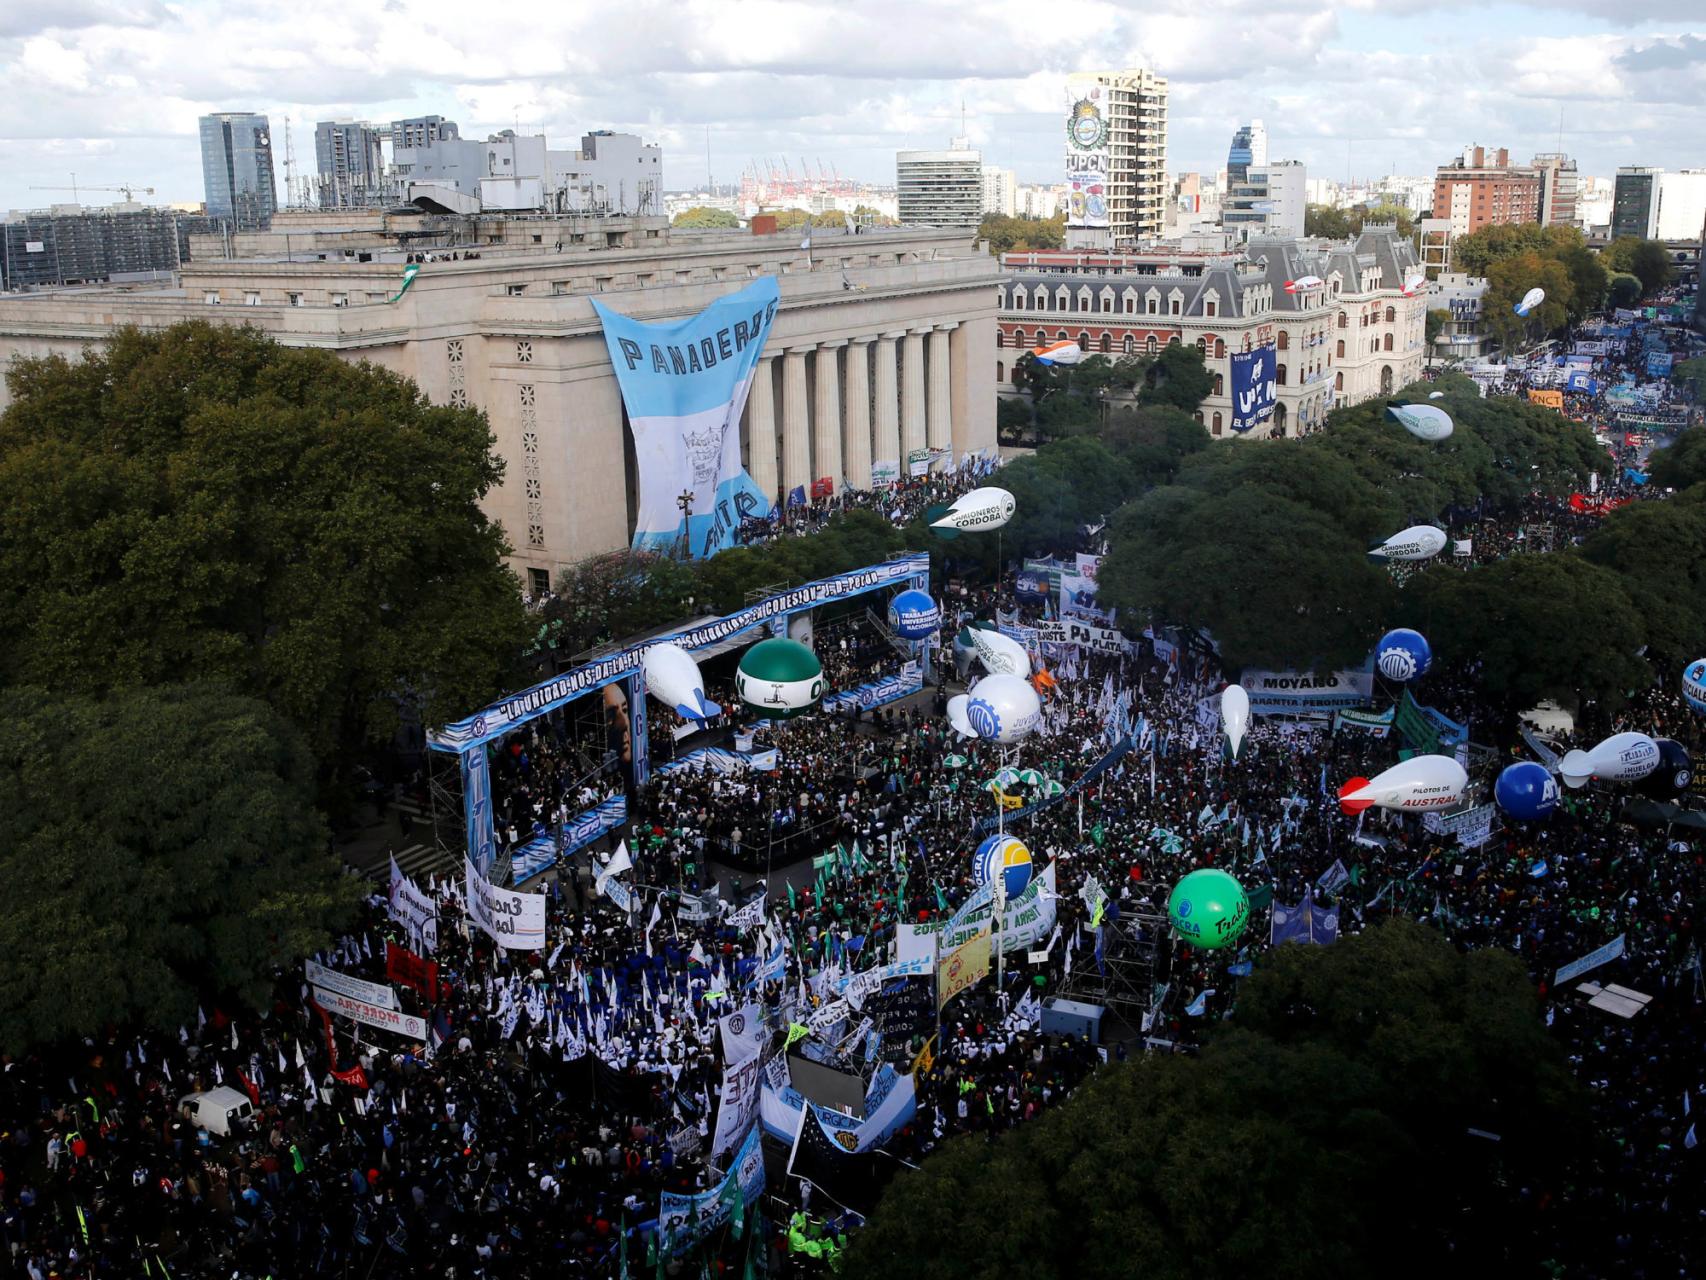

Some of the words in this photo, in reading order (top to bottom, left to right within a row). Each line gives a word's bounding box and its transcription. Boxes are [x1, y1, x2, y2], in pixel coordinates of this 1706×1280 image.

[1068, 154, 1107, 172] UPCN
[951, 505, 1000, 522] CAMIONEROS
[956, 512, 1001, 527] CORDOBA
[1381, 541, 1420, 552] CAMIONEROS
[1385, 548, 1421, 557] CORDOBA
[1071, 625, 1090, 643] PJ
[1101, 630, 1114, 641] LA
[523, 679, 569, 712] UNIDAD
[569, 669, 592, 692] NOS
[595, 663, 609, 680] DA
[612, 655, 626, 675] LA
[686, 611, 752, 649] SOLIDARIDAD
[847, 570, 878, 590] Perón
[1092, 639, 1121, 652] PLATA
[1263, 677, 1339, 689] MOYANO
[1249, 697, 1299, 706] ARANTIA
[1303, 697, 1363, 707] PERONISTA
[1401, 794, 1457, 807] AUSTRAL
[974, 853, 985, 887] OCRA
